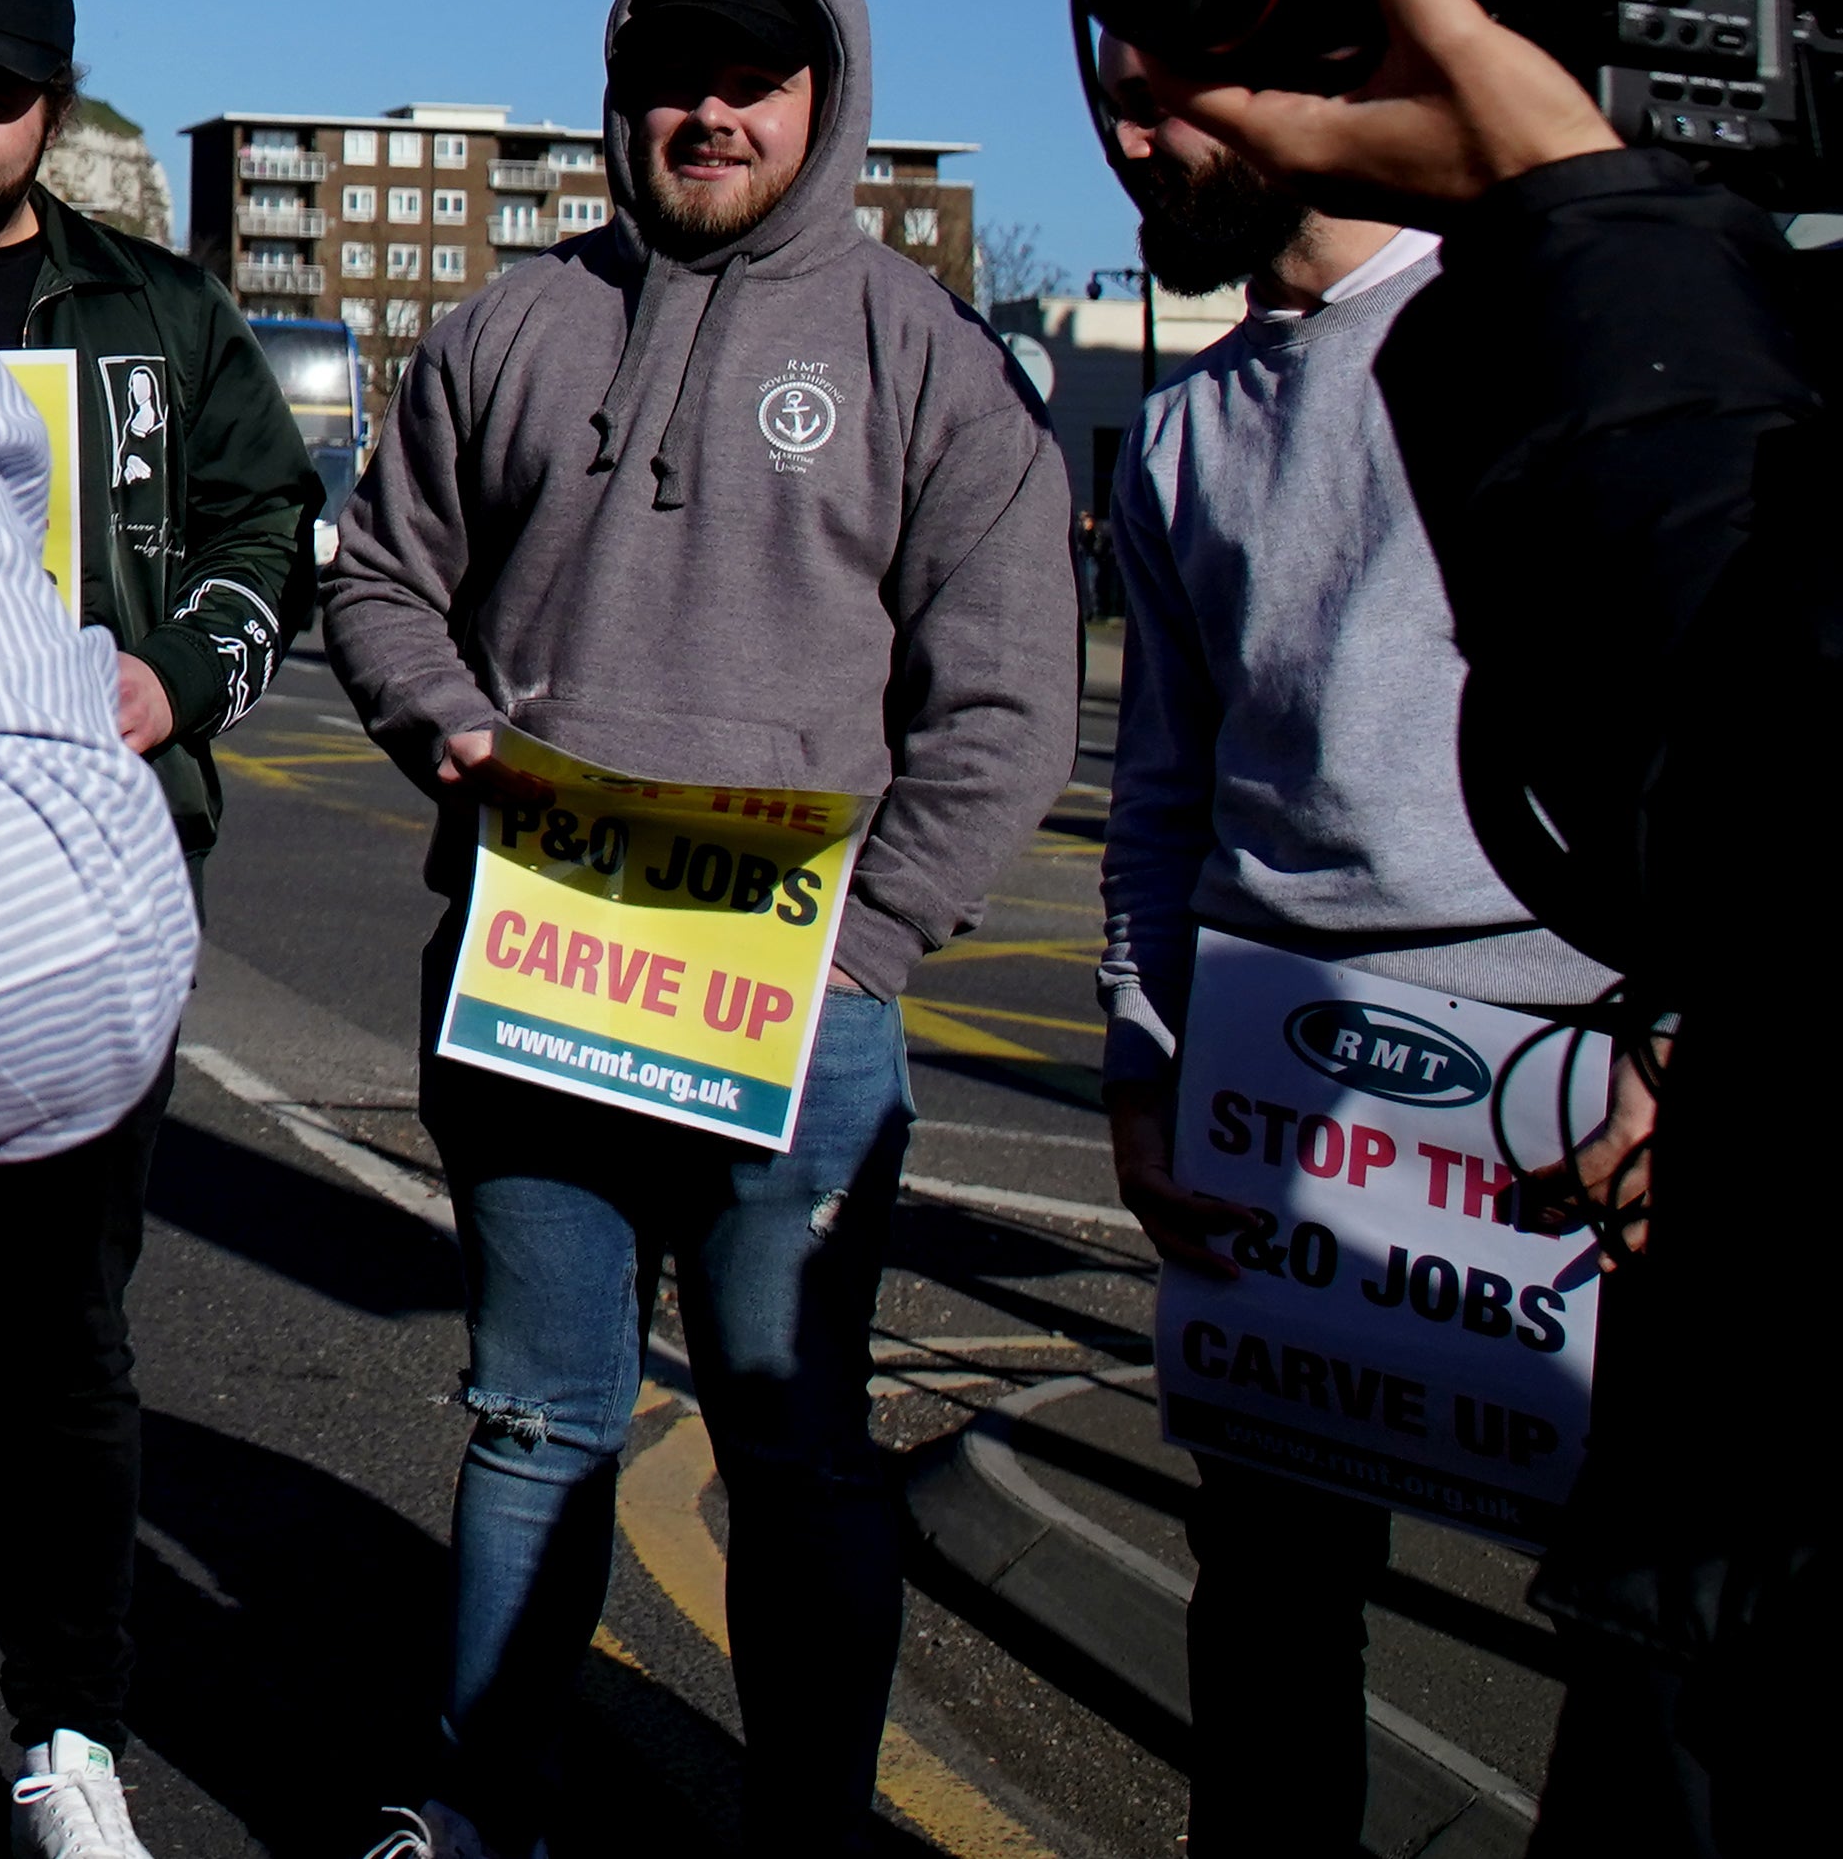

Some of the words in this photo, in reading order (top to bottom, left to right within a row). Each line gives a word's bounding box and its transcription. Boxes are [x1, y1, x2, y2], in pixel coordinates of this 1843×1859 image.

[758, 373, 796, 394] DOVER
[800, 372, 845, 404] SHIPPING
[787, 358, 829, 375] RMT
[499, 803, 630, 875] P&O
[644, 835, 823, 928] JOBS
[484, 908, 687, 1018] CARVE
[701, 968, 795, 1042] UP
[494, 1018, 740, 1112] www.rmt.org.uk
[1334, 1029, 1450, 1084] RMT
[1206, 1088, 1398, 1190] STOP
[1416, 1142, 1563, 1241] TH
[1192, 1191, 1339, 1289] &O
[1359, 1244, 1568, 1354] JOBS
[1181, 1319, 1428, 1440] CARVE
[1453, 1393, 1562, 1470] UP
